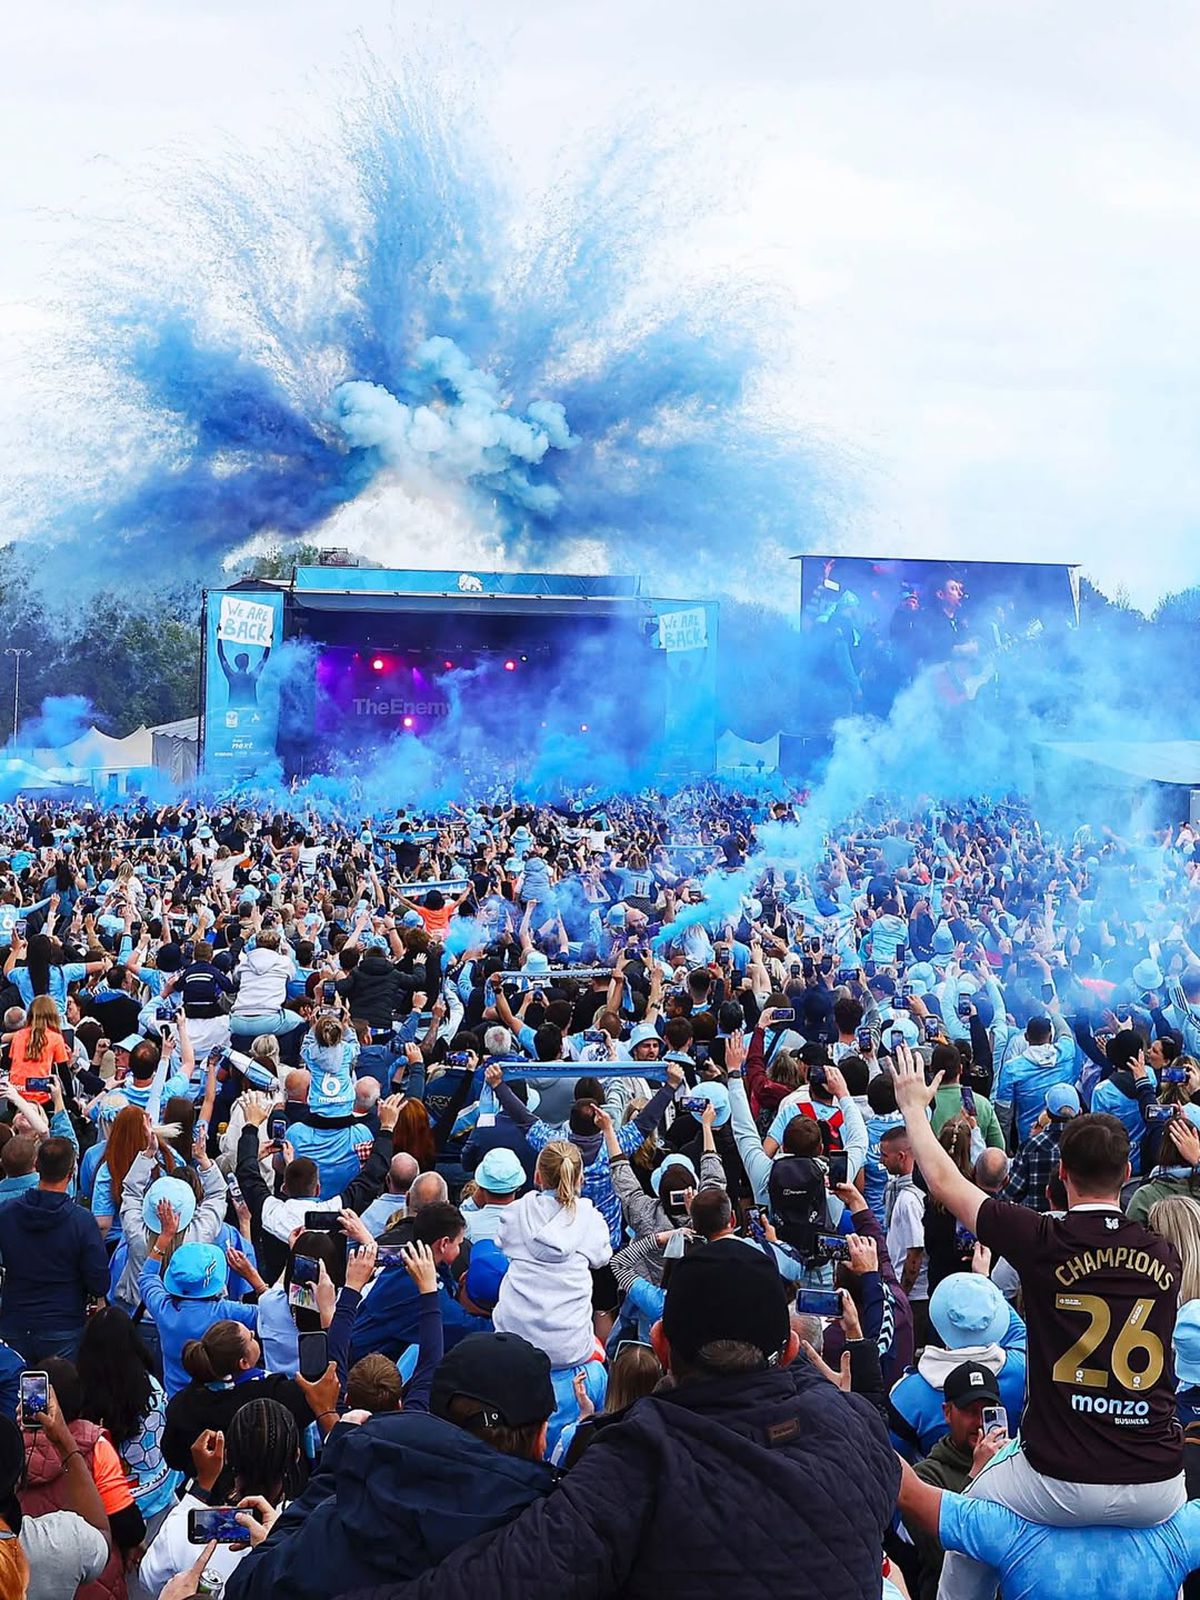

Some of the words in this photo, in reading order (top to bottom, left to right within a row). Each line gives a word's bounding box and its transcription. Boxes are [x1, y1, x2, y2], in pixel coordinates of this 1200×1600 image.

[228, 602, 245, 617] WE
[247, 606, 268, 622] ARE
[223, 618, 267, 641] BACK
[665, 628, 702, 648] BACK
[322, 1071, 341, 1097] 6
[1055, 1247, 1174, 1291] CHAMPIONS
[1052, 1293, 1164, 1391] 26
[1071, 1394, 1149, 1416] monzo
[1114, 1417, 1149, 1425] BUSINESS
